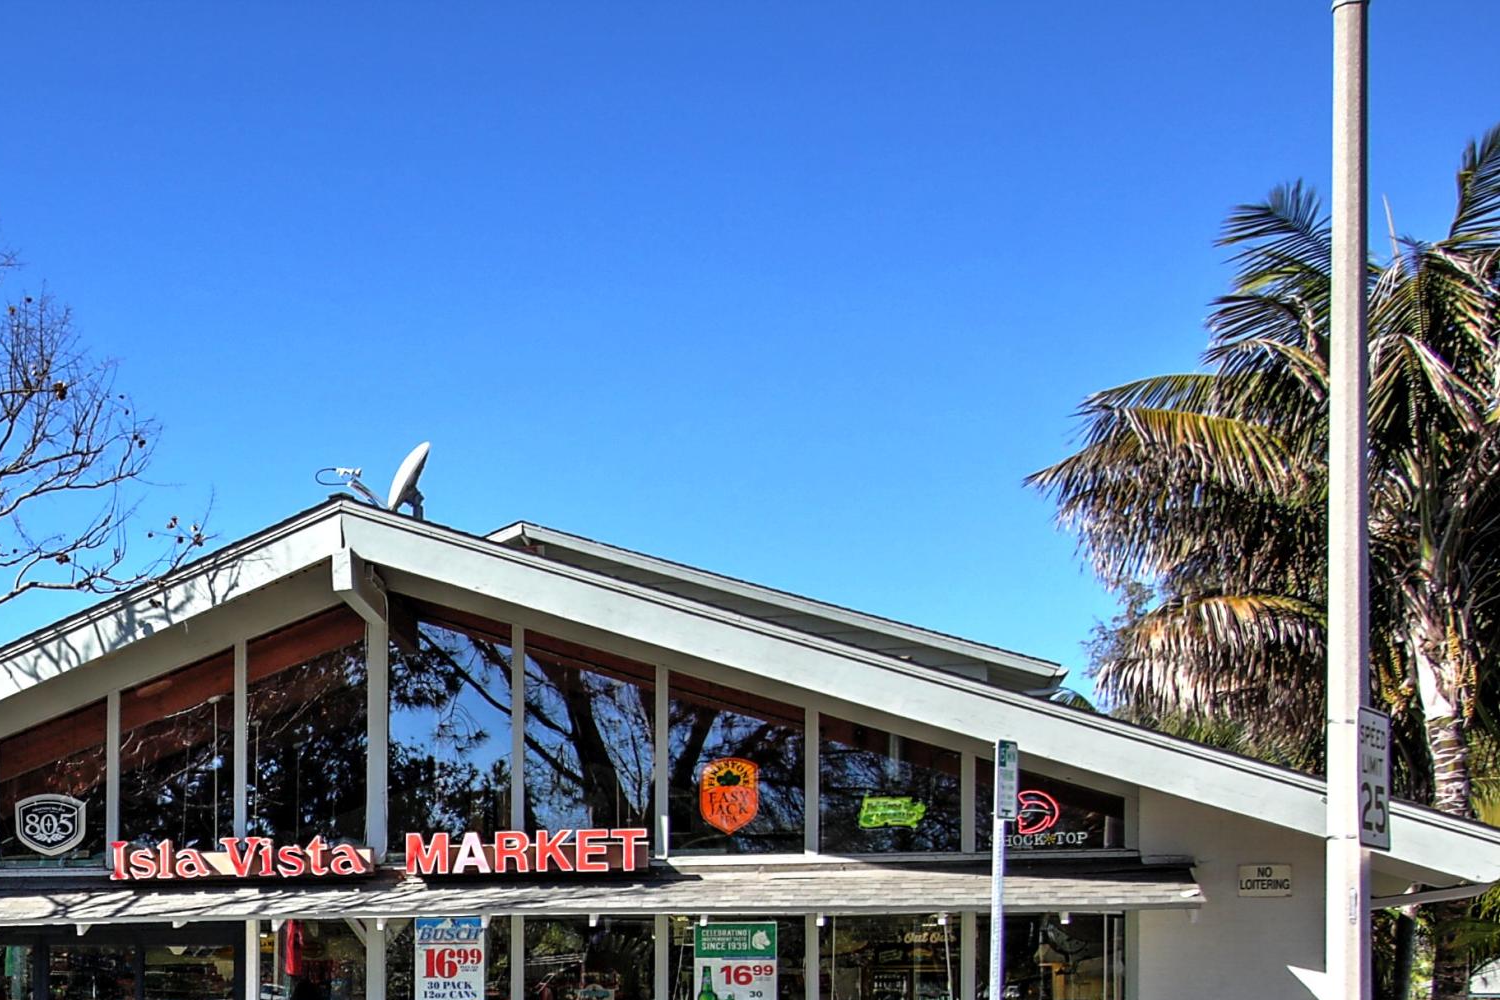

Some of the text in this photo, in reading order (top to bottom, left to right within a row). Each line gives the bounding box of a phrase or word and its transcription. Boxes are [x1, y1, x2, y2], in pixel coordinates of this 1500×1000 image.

[1360, 725, 1386, 750] SPEED
[1362, 755, 1383, 777] LIMIT
[707, 762, 749, 787] FIRESTONE
[708, 791, 749, 804] EASY
[709, 803, 748, 817] JACK
[1361, 782, 1386, 834] 25
[25, 813, 74, 836] 805
[1055, 831, 1088, 845] TOP
[405, 828, 648, 874] MARKET
[110, 835, 366, 881] Isla Vista
[1257, 867, 1272, 878] NO
[1240, 879, 1290, 890] LOITERING
[420, 927, 484, 940] BUSCH
[701, 929, 747, 937] CELEBRATING
[701, 942, 747, 950] SINCE 1939
[428, 981, 473, 990] 30 PACK
[423, 990, 478, 999] 12oz CANS
[749, 990, 763, 998] 30
